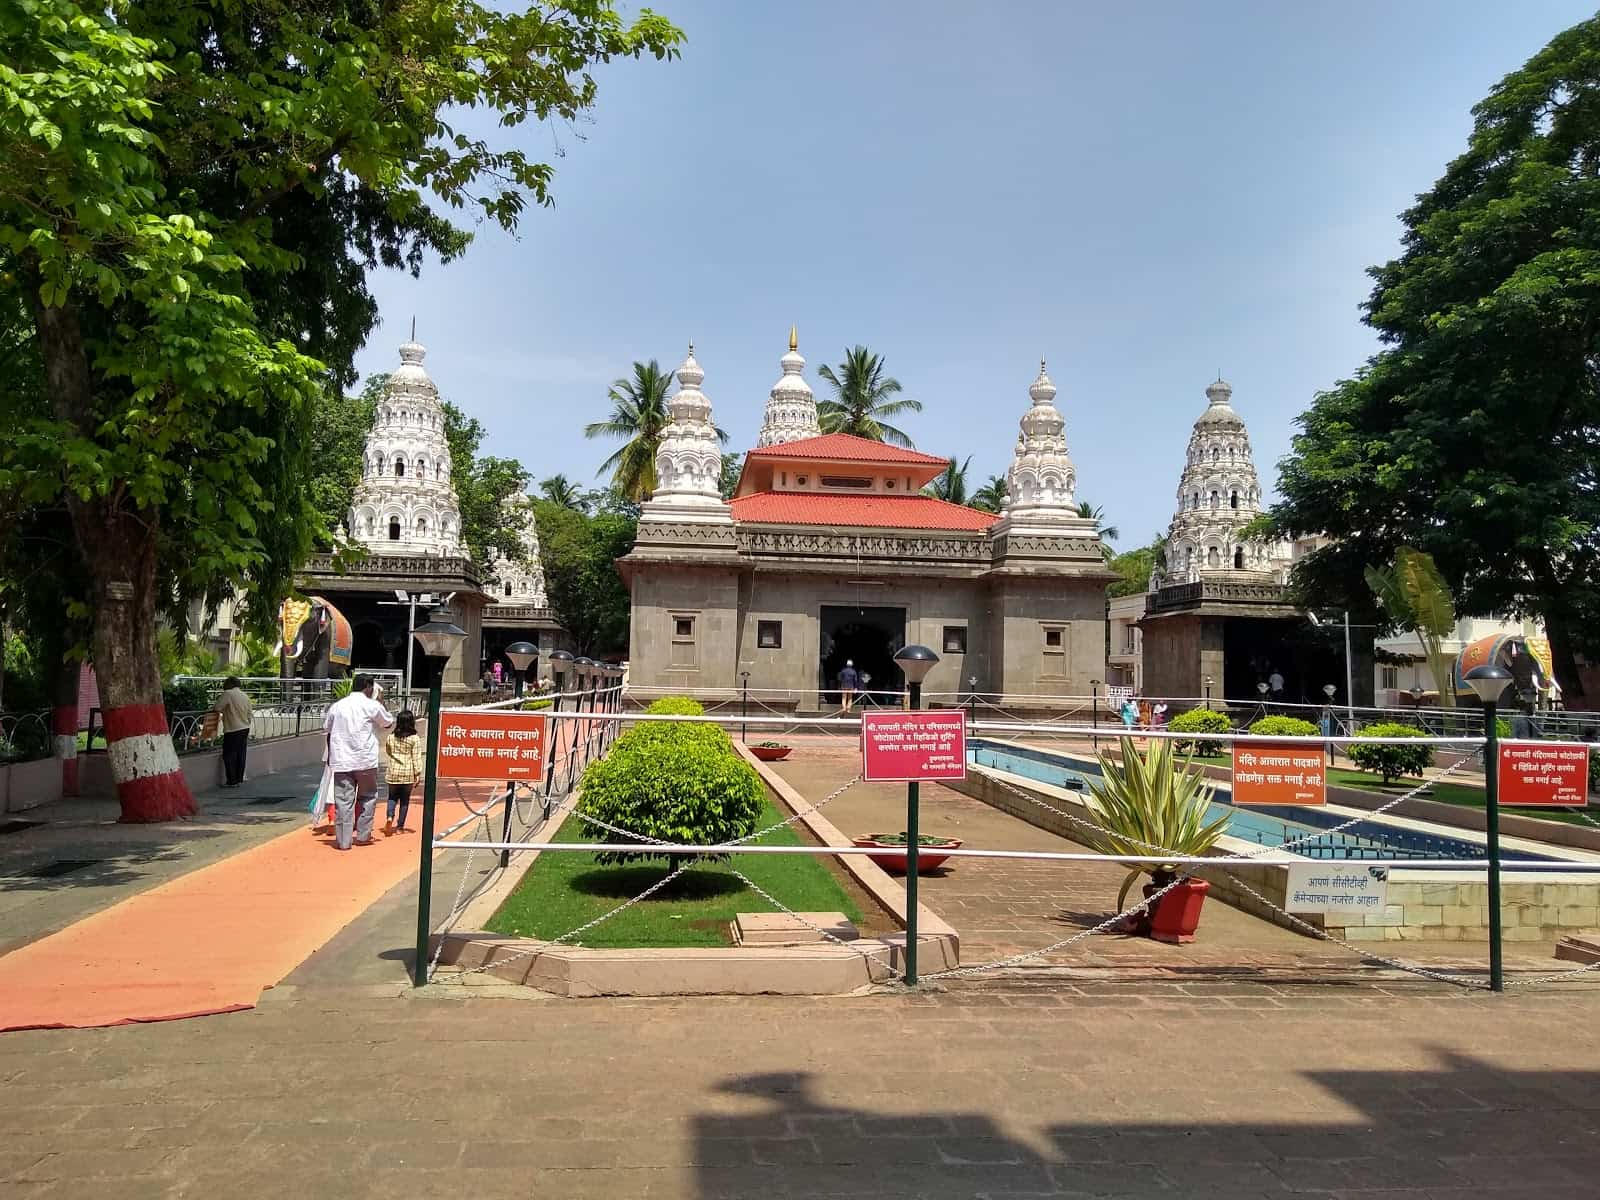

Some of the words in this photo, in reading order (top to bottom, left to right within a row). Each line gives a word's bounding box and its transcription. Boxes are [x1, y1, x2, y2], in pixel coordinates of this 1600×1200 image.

[446, 725, 466, 739] मंदिर
[470, 728, 504, 740] आवारात
[508, 728, 539, 741] पादत्राणे
[441, 744, 473, 757] सोडणेस
[477, 748, 494, 758] सक्त
[498, 746, 519, 760] मनाई
[521, 747, 541, 760] आहे.
[1239, 752, 1256, 766] मंदिर
[1260, 757, 1290, 766] आवारात
[1293, 756, 1320, 768] पादत्राणे
[1236, 771, 1264, 784] सोडणेस
[1266, 775, 1282, 783] सक्त
[1285, 772, 1303, 786] मनाई
[1332, 875, 1368, 890] सीसीटीव्ही
[1332, 892, 1354, 904] नजरेत
[1356, 896, 1379, 906] आहात
